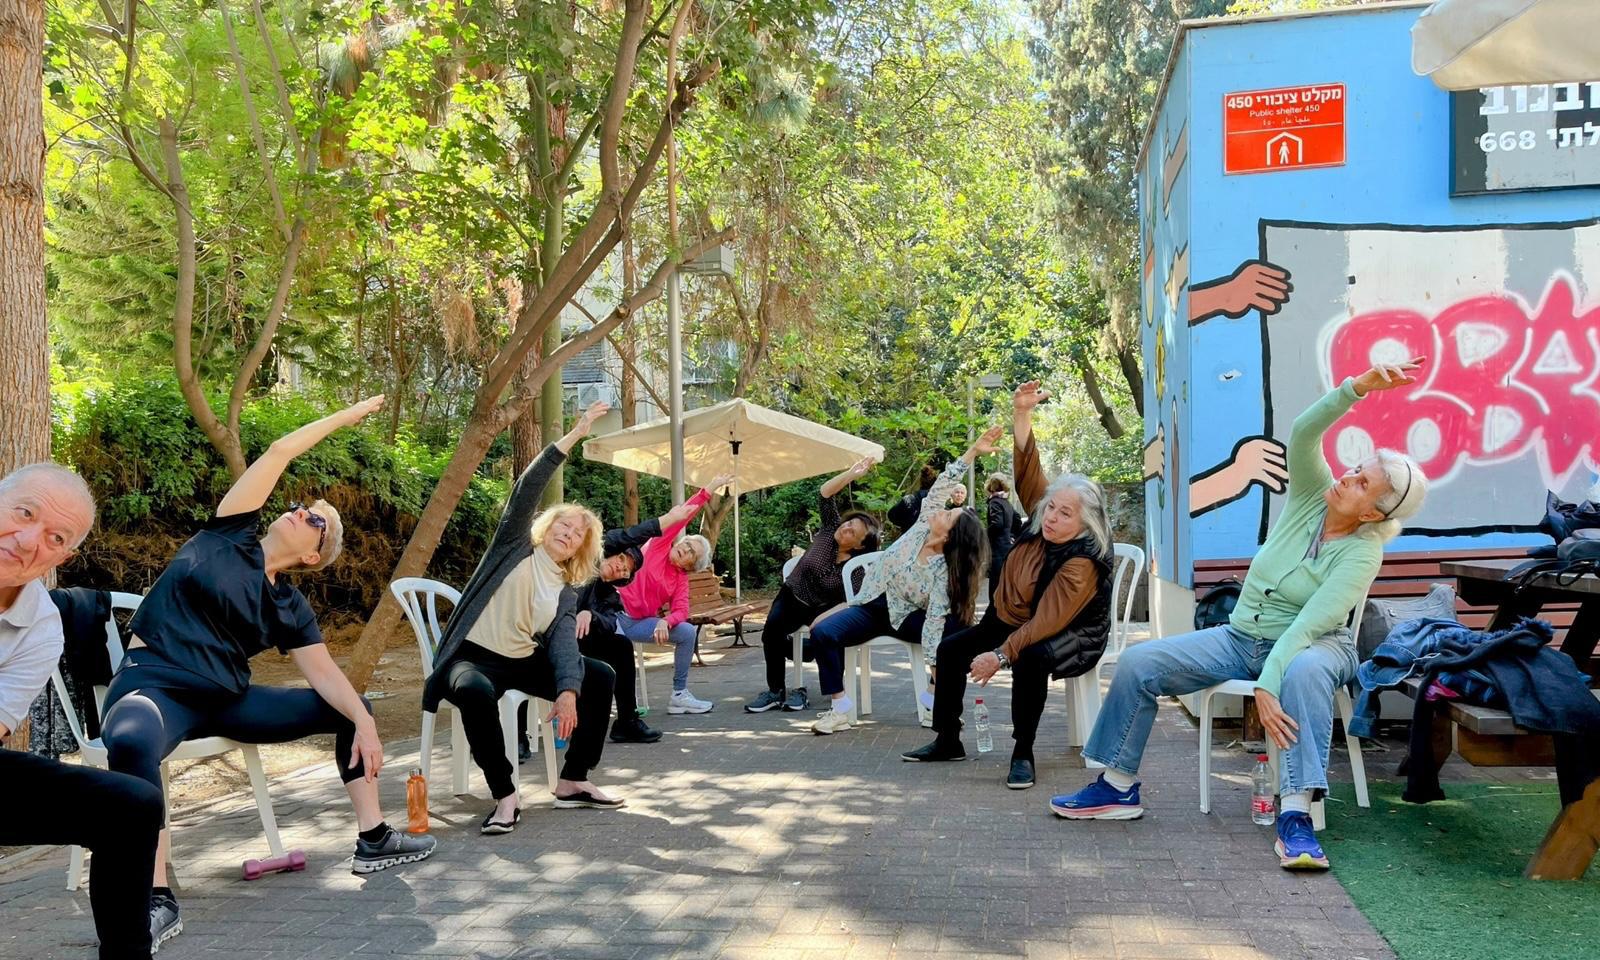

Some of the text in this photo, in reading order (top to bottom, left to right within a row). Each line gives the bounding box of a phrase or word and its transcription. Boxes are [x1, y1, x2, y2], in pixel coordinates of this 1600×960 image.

[1227, 87, 1342, 109] מקלט ציבורי 450
[1249, 104, 1320, 117] Public shelter 450
[1479, 82, 1600, 116] ובנוב
[1479, 121, 1600, 153] לתי 668
